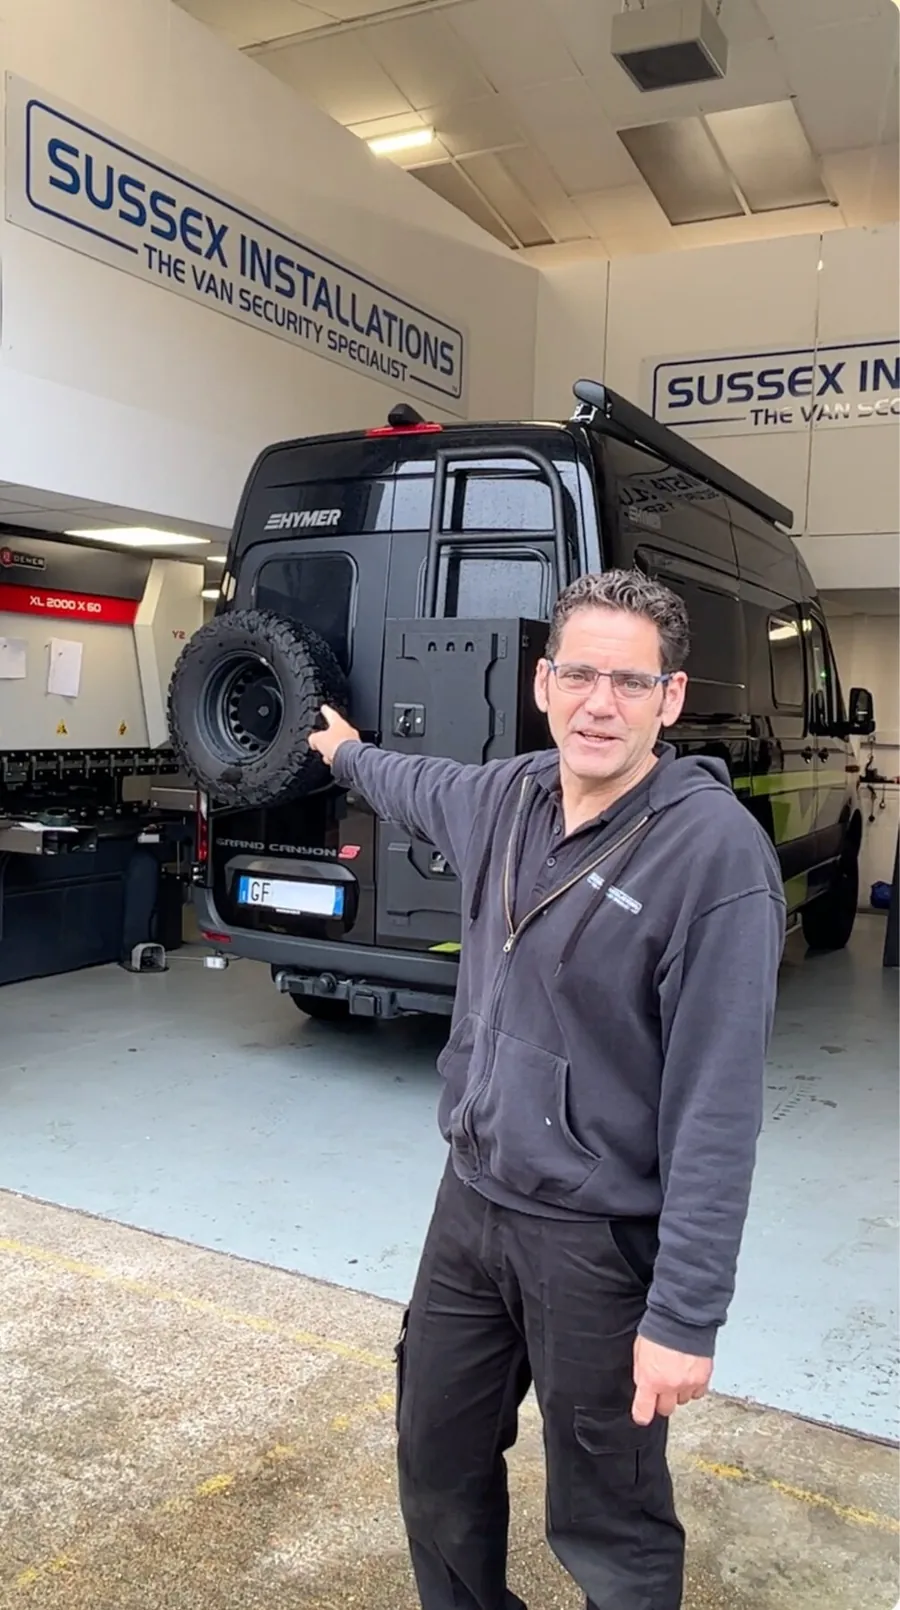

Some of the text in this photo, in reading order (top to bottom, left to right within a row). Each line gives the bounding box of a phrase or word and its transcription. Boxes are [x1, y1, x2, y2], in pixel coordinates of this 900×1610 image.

[47, 138, 455, 377] SUSSEX INSTALLATIONS
[143, 243, 408, 382] THE VAN SECURITY SPECIALIST
[668, 362, 846, 409] SUSSEX
[750, 406, 793, 426] THE
[800, 402, 850, 422] VAN
[264, 508, 342, 530] HYMER
[29, 595, 102, 613] XL 2000 X 60
[216, 838, 265, 851] GRAND
[269, 843, 336, 857] CANYON
[251, 881, 271, 902] GF
